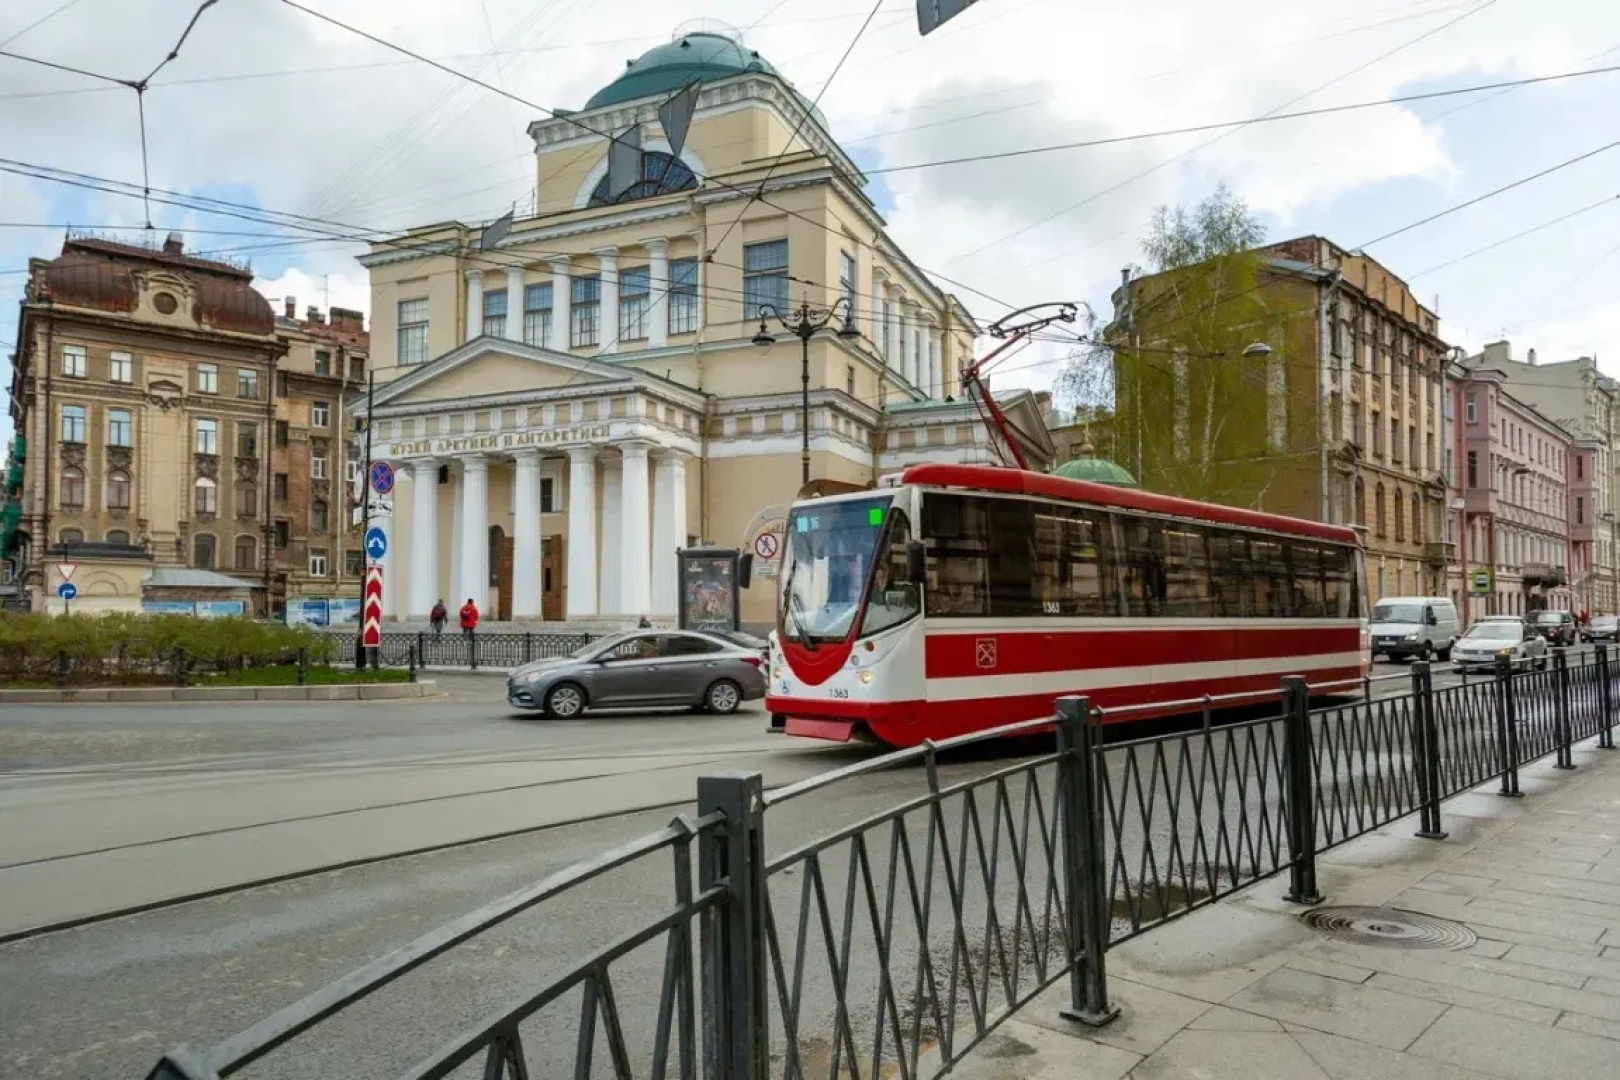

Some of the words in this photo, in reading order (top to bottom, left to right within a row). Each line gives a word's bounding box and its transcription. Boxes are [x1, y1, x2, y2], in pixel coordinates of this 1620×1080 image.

[390, 439, 431, 455] МУЗЕЙ
[437, 434, 498, 450] АРКТИКИ
[504, 432, 513, 446] И
[517, 425, 610, 445] АНТАРКТИКИ
[1042, 602, 1060, 613] 1363
[829, 687, 849, 699] 1363
